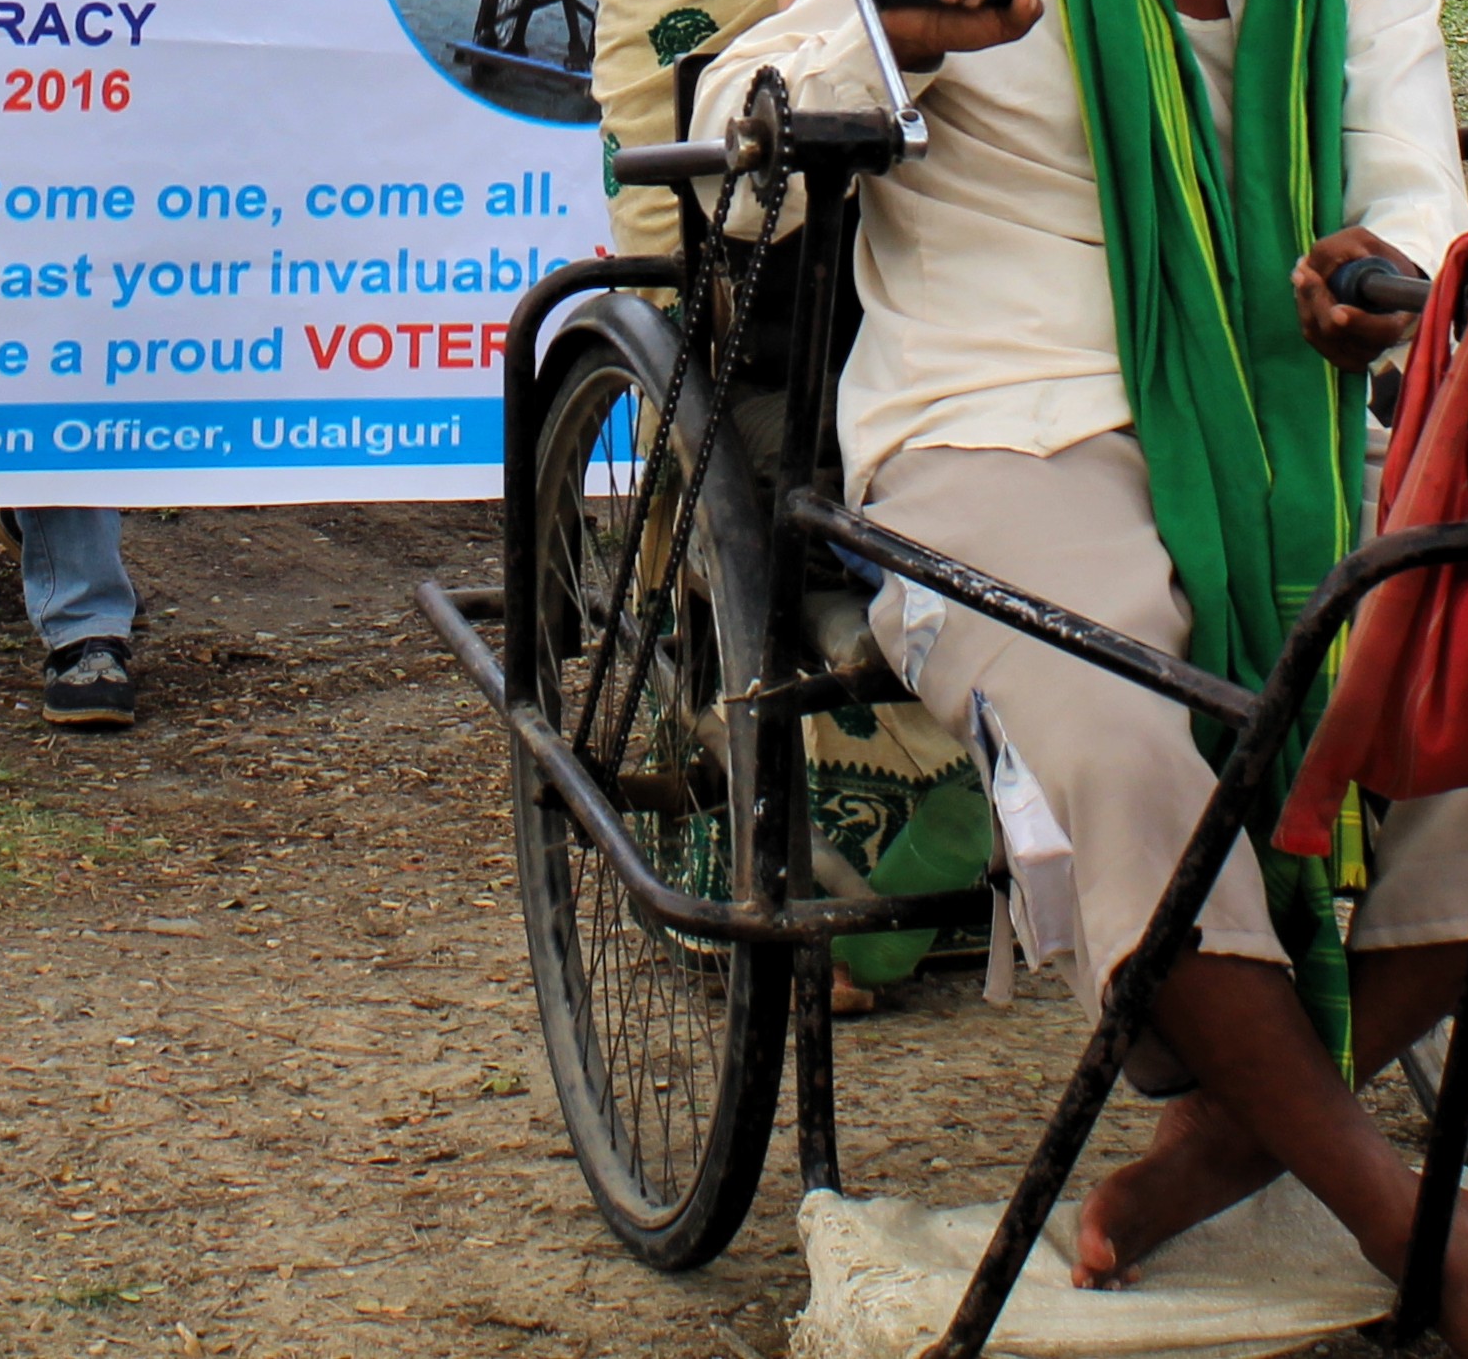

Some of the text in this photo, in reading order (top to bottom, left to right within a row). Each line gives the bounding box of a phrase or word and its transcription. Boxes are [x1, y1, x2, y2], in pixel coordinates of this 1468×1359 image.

[4, 69, 130, 111] 2016
[157, 185, 282, 226] one,
[306, 183, 465, 219] come
[486, 172, 568, 217] all.
[112, 261, 251, 309] your
[50, 341, 82, 376] a
[106, 327, 283, 386] proud
[305, 323, 510, 370] VOTER
[53, 419, 231, 455] Officer,
[253, 415, 460, 455] Udalguri
